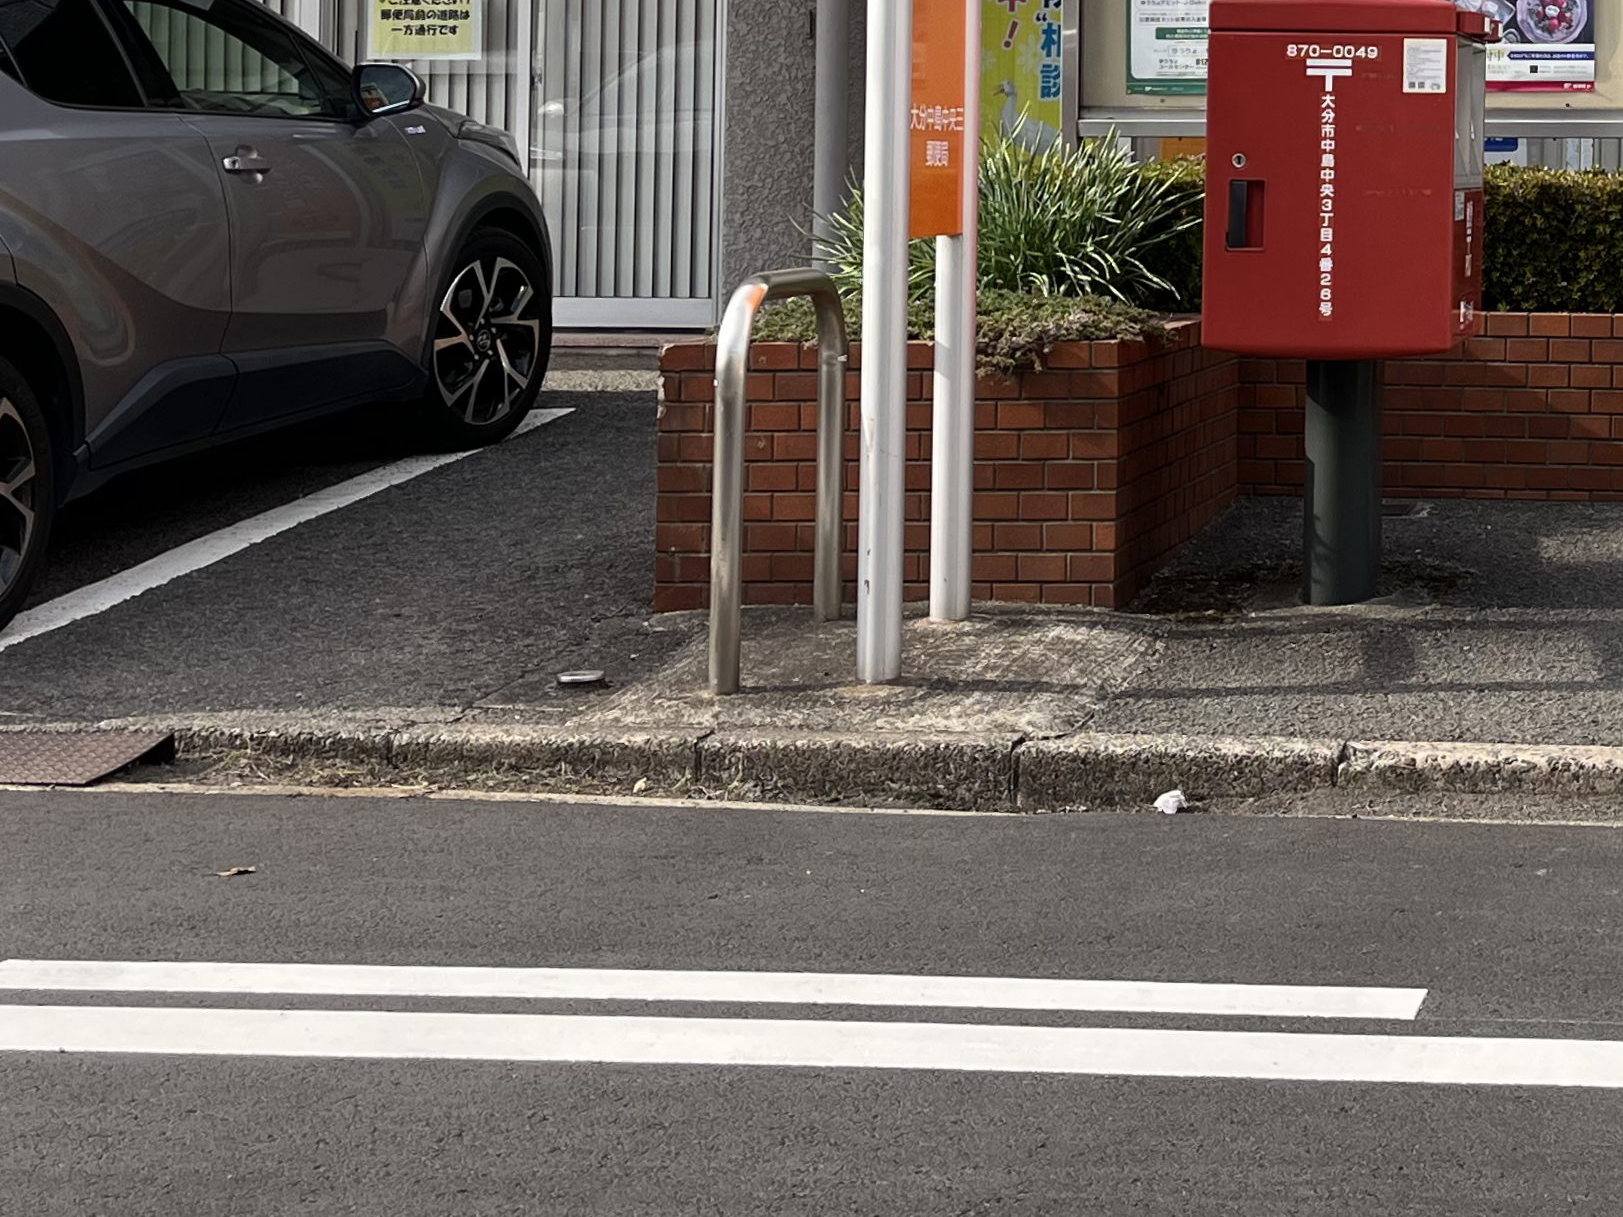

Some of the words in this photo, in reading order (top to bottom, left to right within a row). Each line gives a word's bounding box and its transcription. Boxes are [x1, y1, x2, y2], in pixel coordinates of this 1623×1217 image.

[391, 25, 458, 36] 一方通行です
[1286, 44, 1378, 58] 870-0049
[1319, 94, 1336, 317] 大分市中島中央3丁目4番26号
